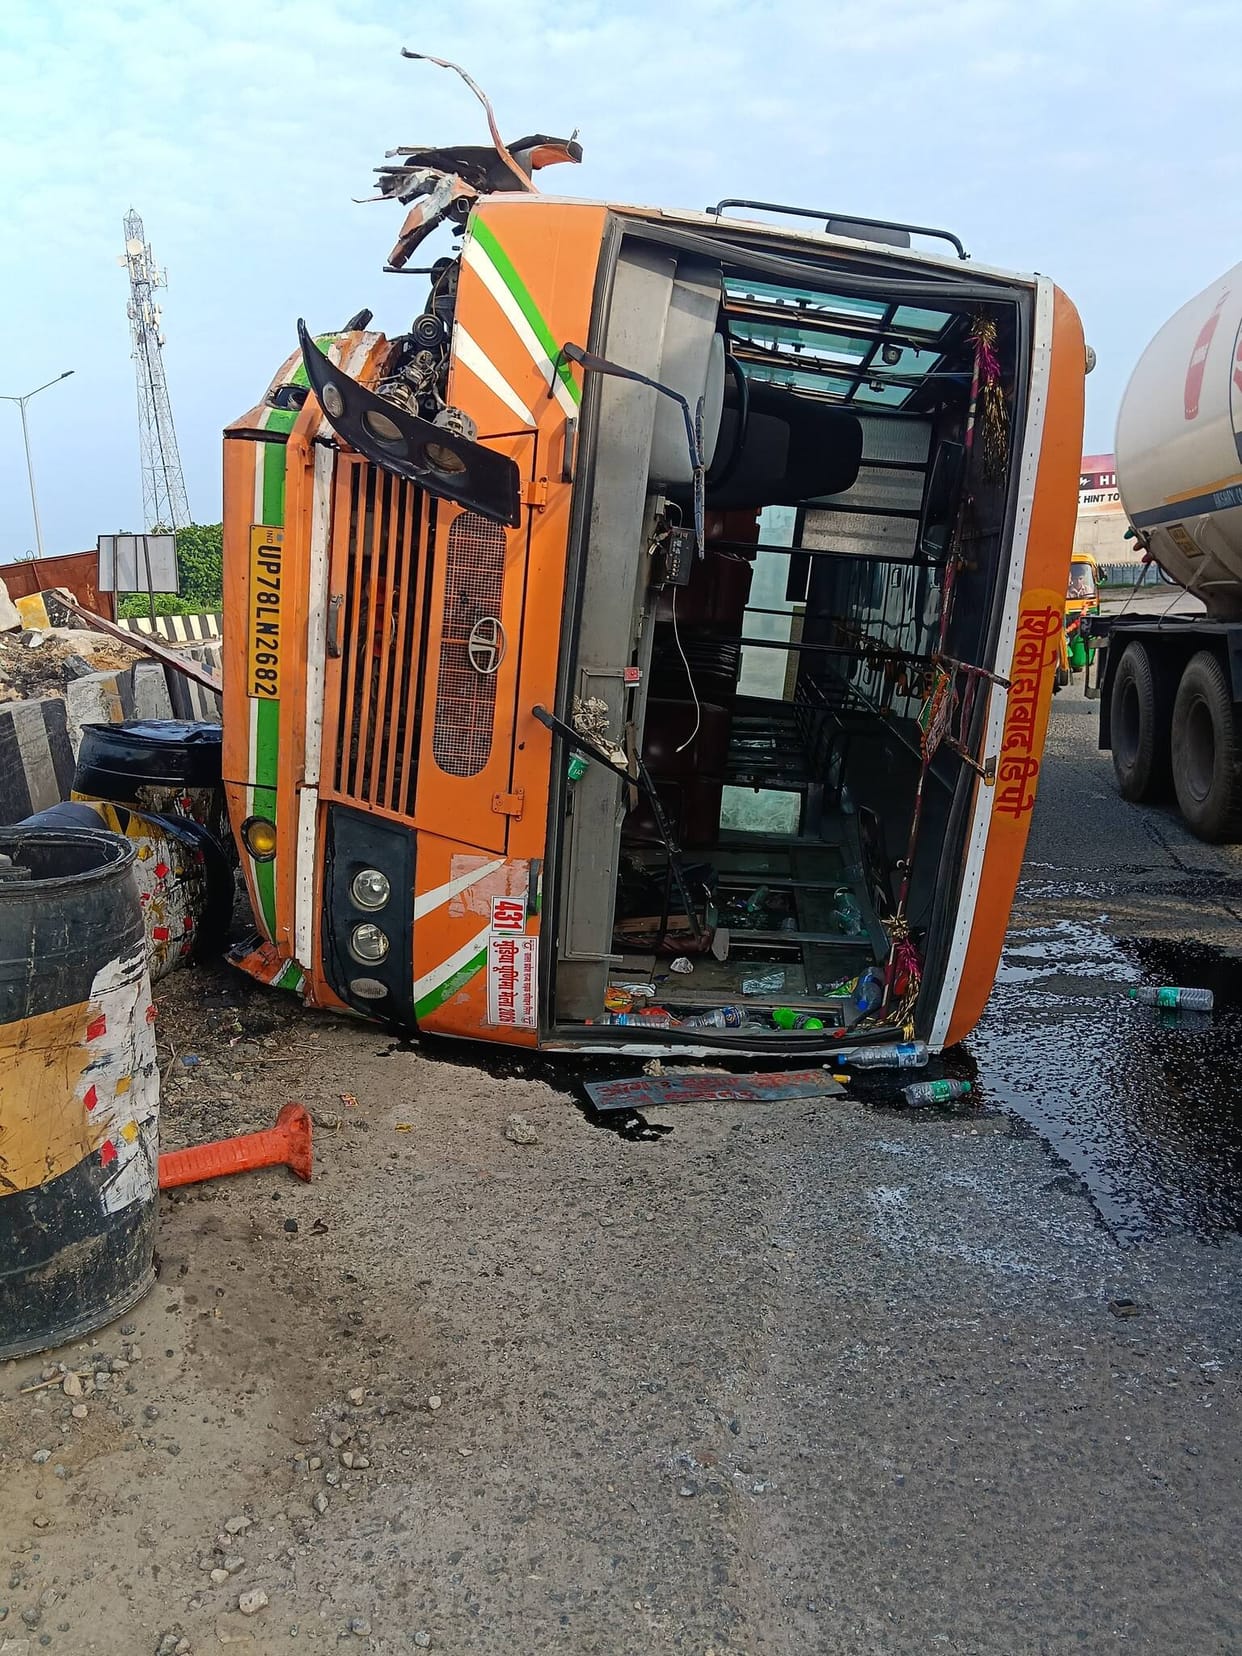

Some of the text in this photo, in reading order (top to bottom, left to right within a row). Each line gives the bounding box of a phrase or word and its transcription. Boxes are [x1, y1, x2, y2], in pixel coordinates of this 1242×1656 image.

[1083, 493, 1106, 504] HINT
[265, 530, 274, 544] IND
[254, 544, 283, 697] UP78LN2682
[995, 606, 1062, 820] शिकोहाबाद डिपो
[493, 900, 524, 930] 431
[492, 940, 520, 964] मुड़िया
[492, 965, 520, 990] पूर्णिमा
[497, 991, 519, 1008] मेला
